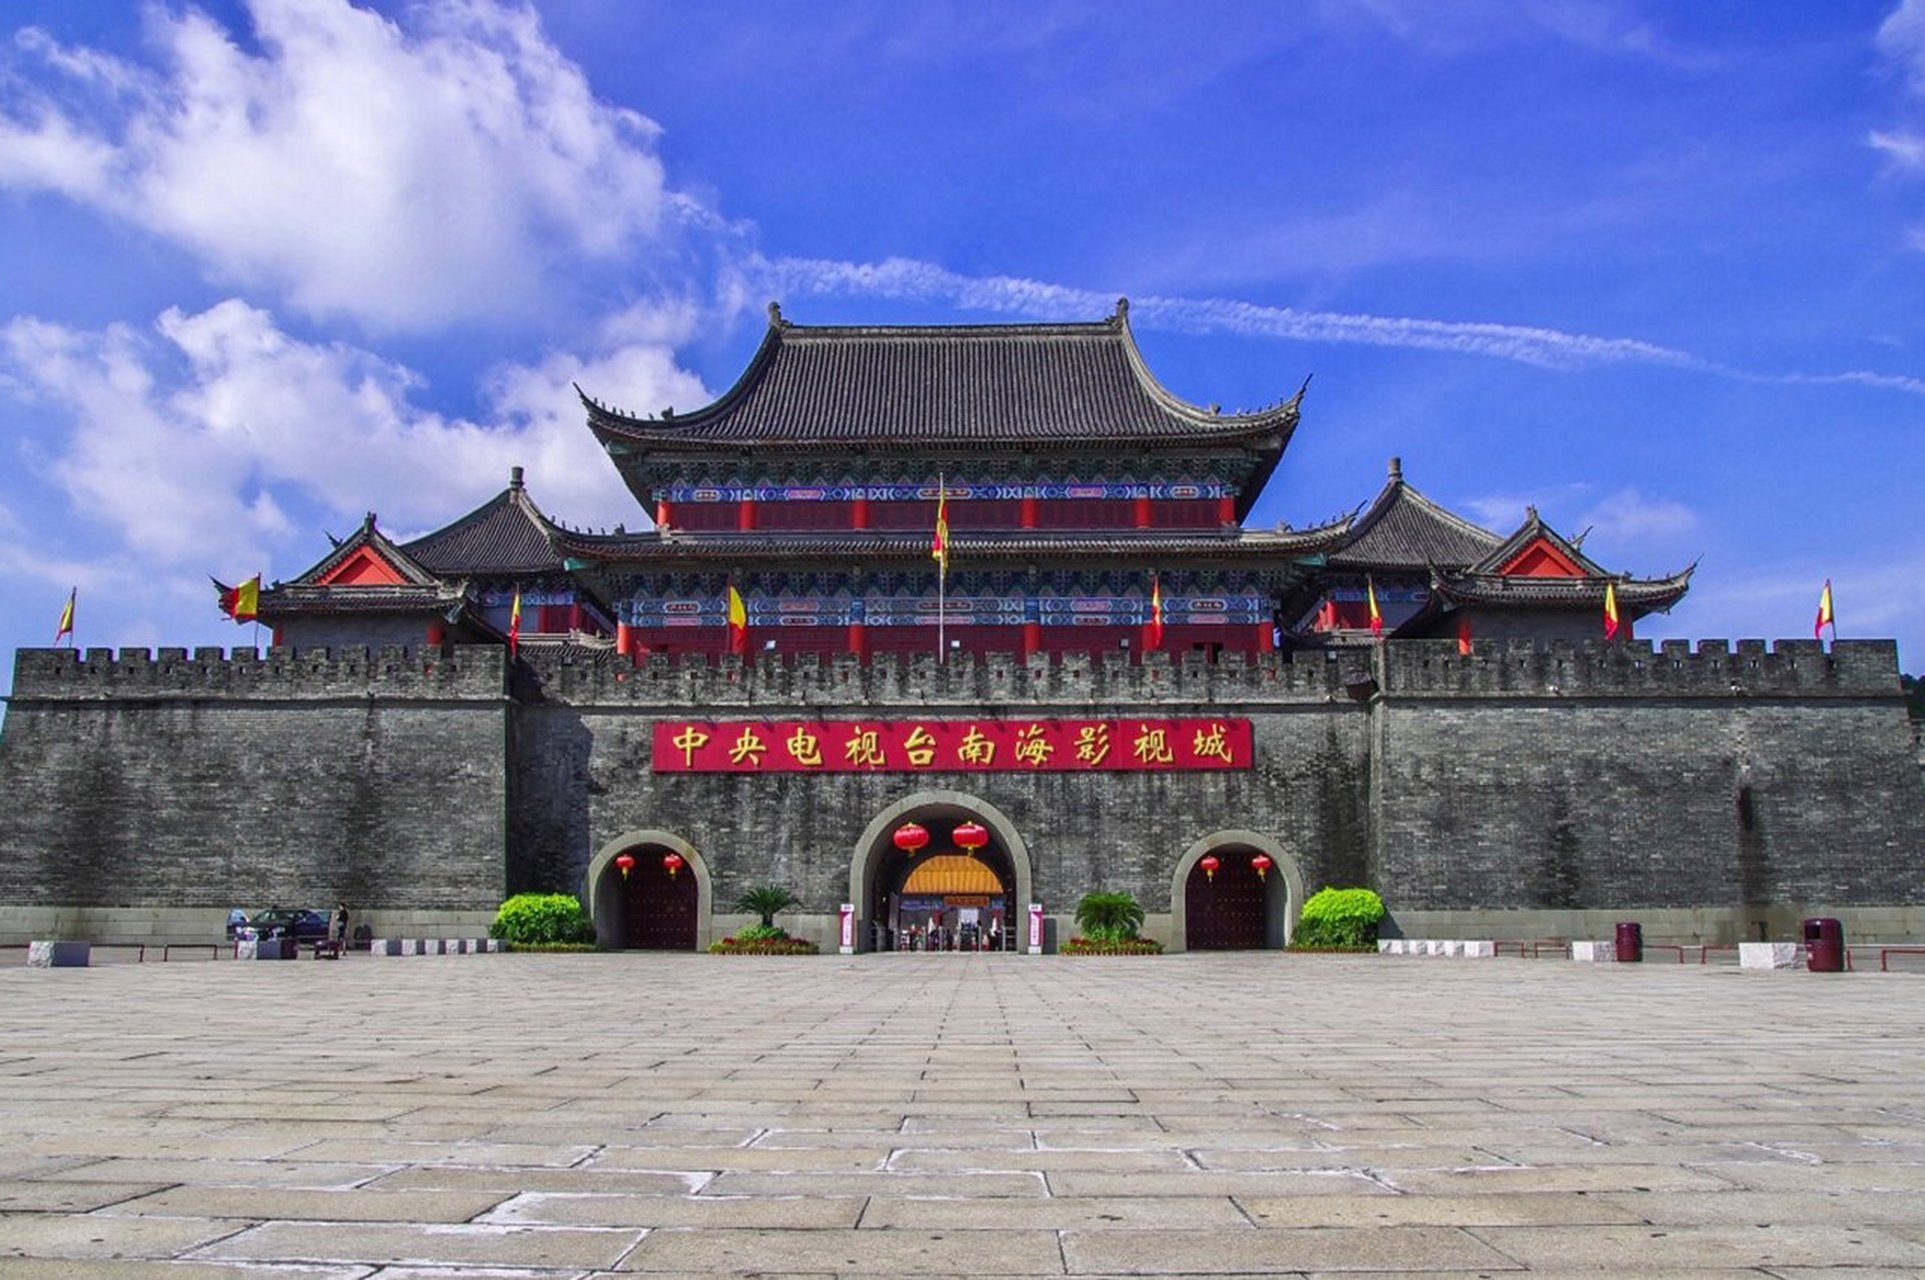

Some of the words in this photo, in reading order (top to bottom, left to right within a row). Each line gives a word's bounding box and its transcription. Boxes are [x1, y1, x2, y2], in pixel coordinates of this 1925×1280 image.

[672, 724, 1233, 766] 中央电视台南海影视城
